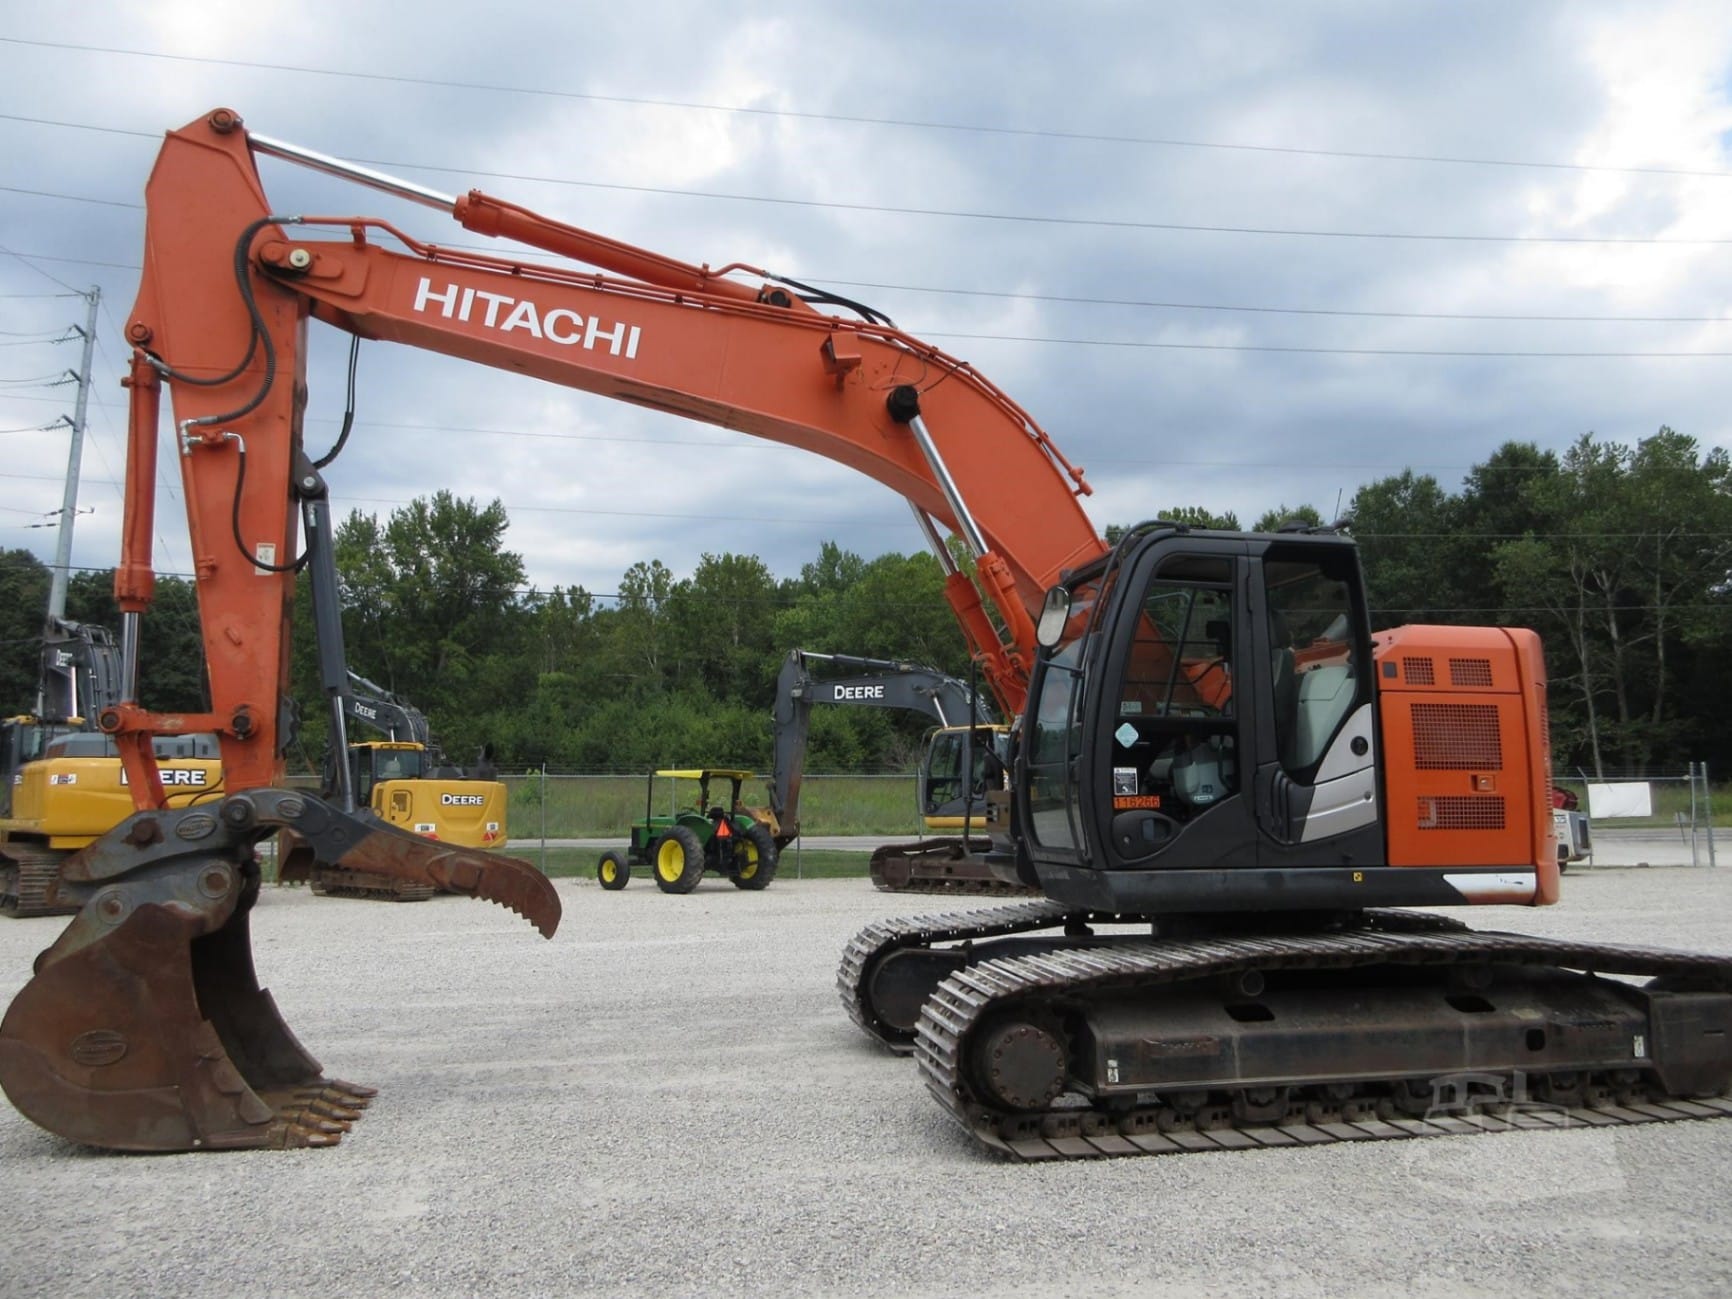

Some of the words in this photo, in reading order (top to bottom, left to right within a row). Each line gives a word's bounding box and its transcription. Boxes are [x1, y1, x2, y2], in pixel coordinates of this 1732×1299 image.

[413, 277, 642, 360] HITACHI
[834, 685, 885, 700] DEERE
[121, 768, 206, 785] ERE
[441, 794, 484, 805] DEERE
